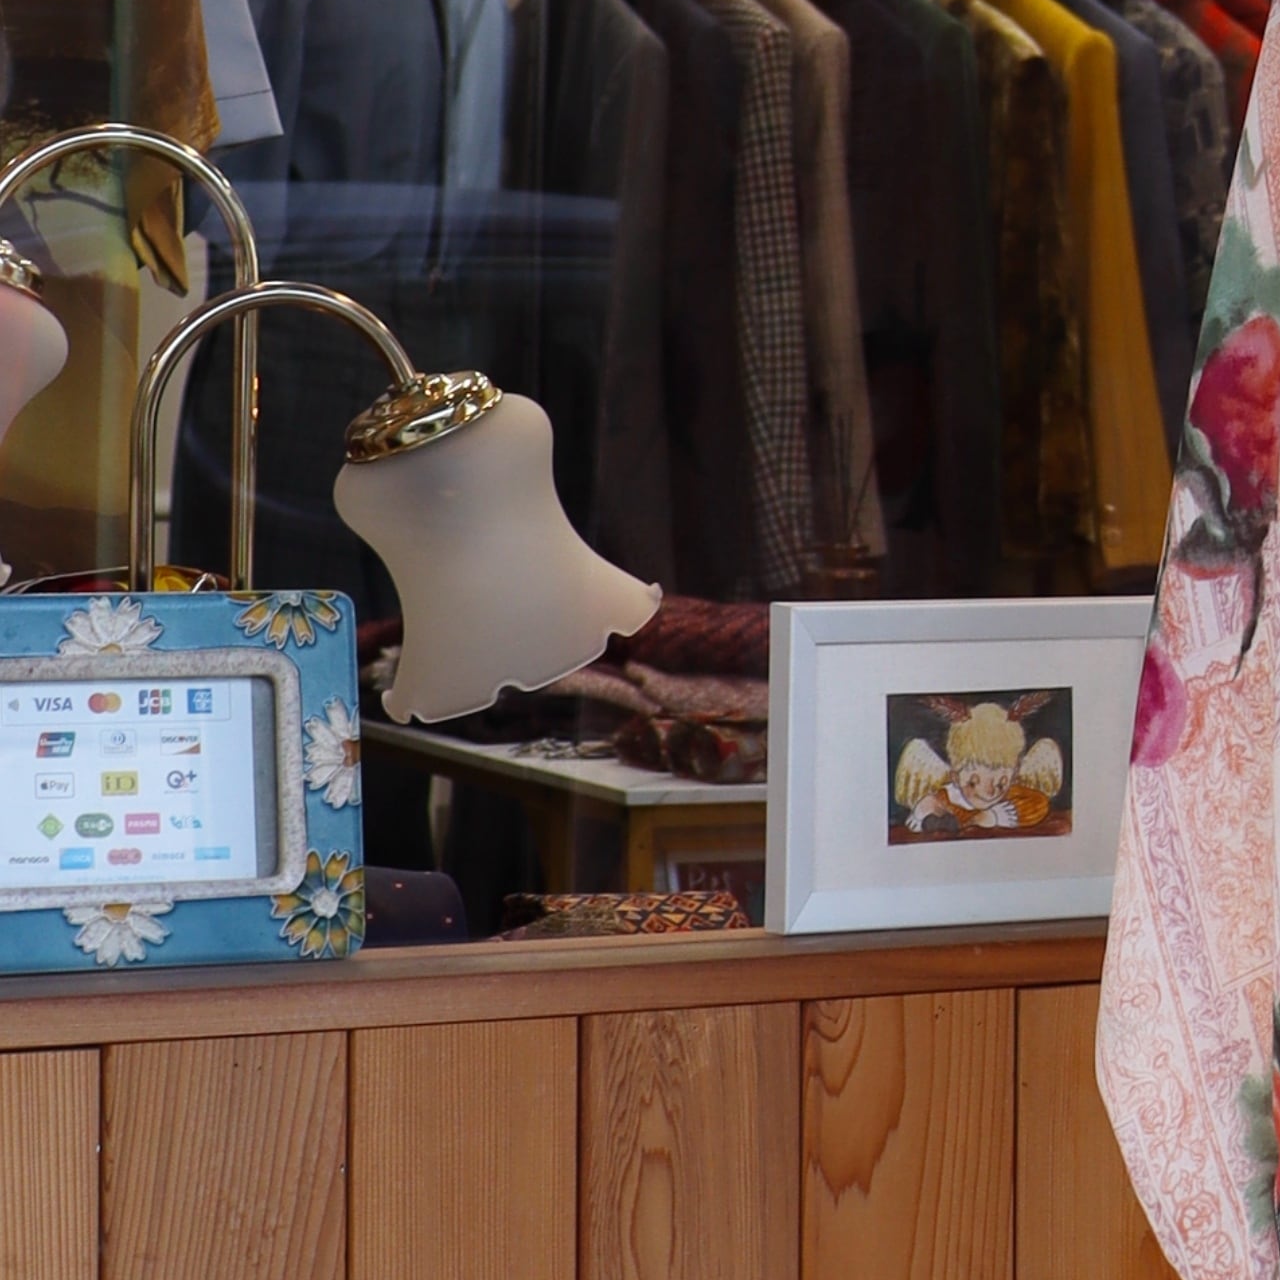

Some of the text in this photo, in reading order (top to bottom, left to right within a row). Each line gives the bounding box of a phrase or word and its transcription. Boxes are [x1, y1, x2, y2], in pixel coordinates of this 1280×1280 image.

[33, 696, 73, 712] VISA
[138, 693, 172, 711] JCB
[49, 779, 69, 793] Pay
[105, 775, 136, 791] iD
